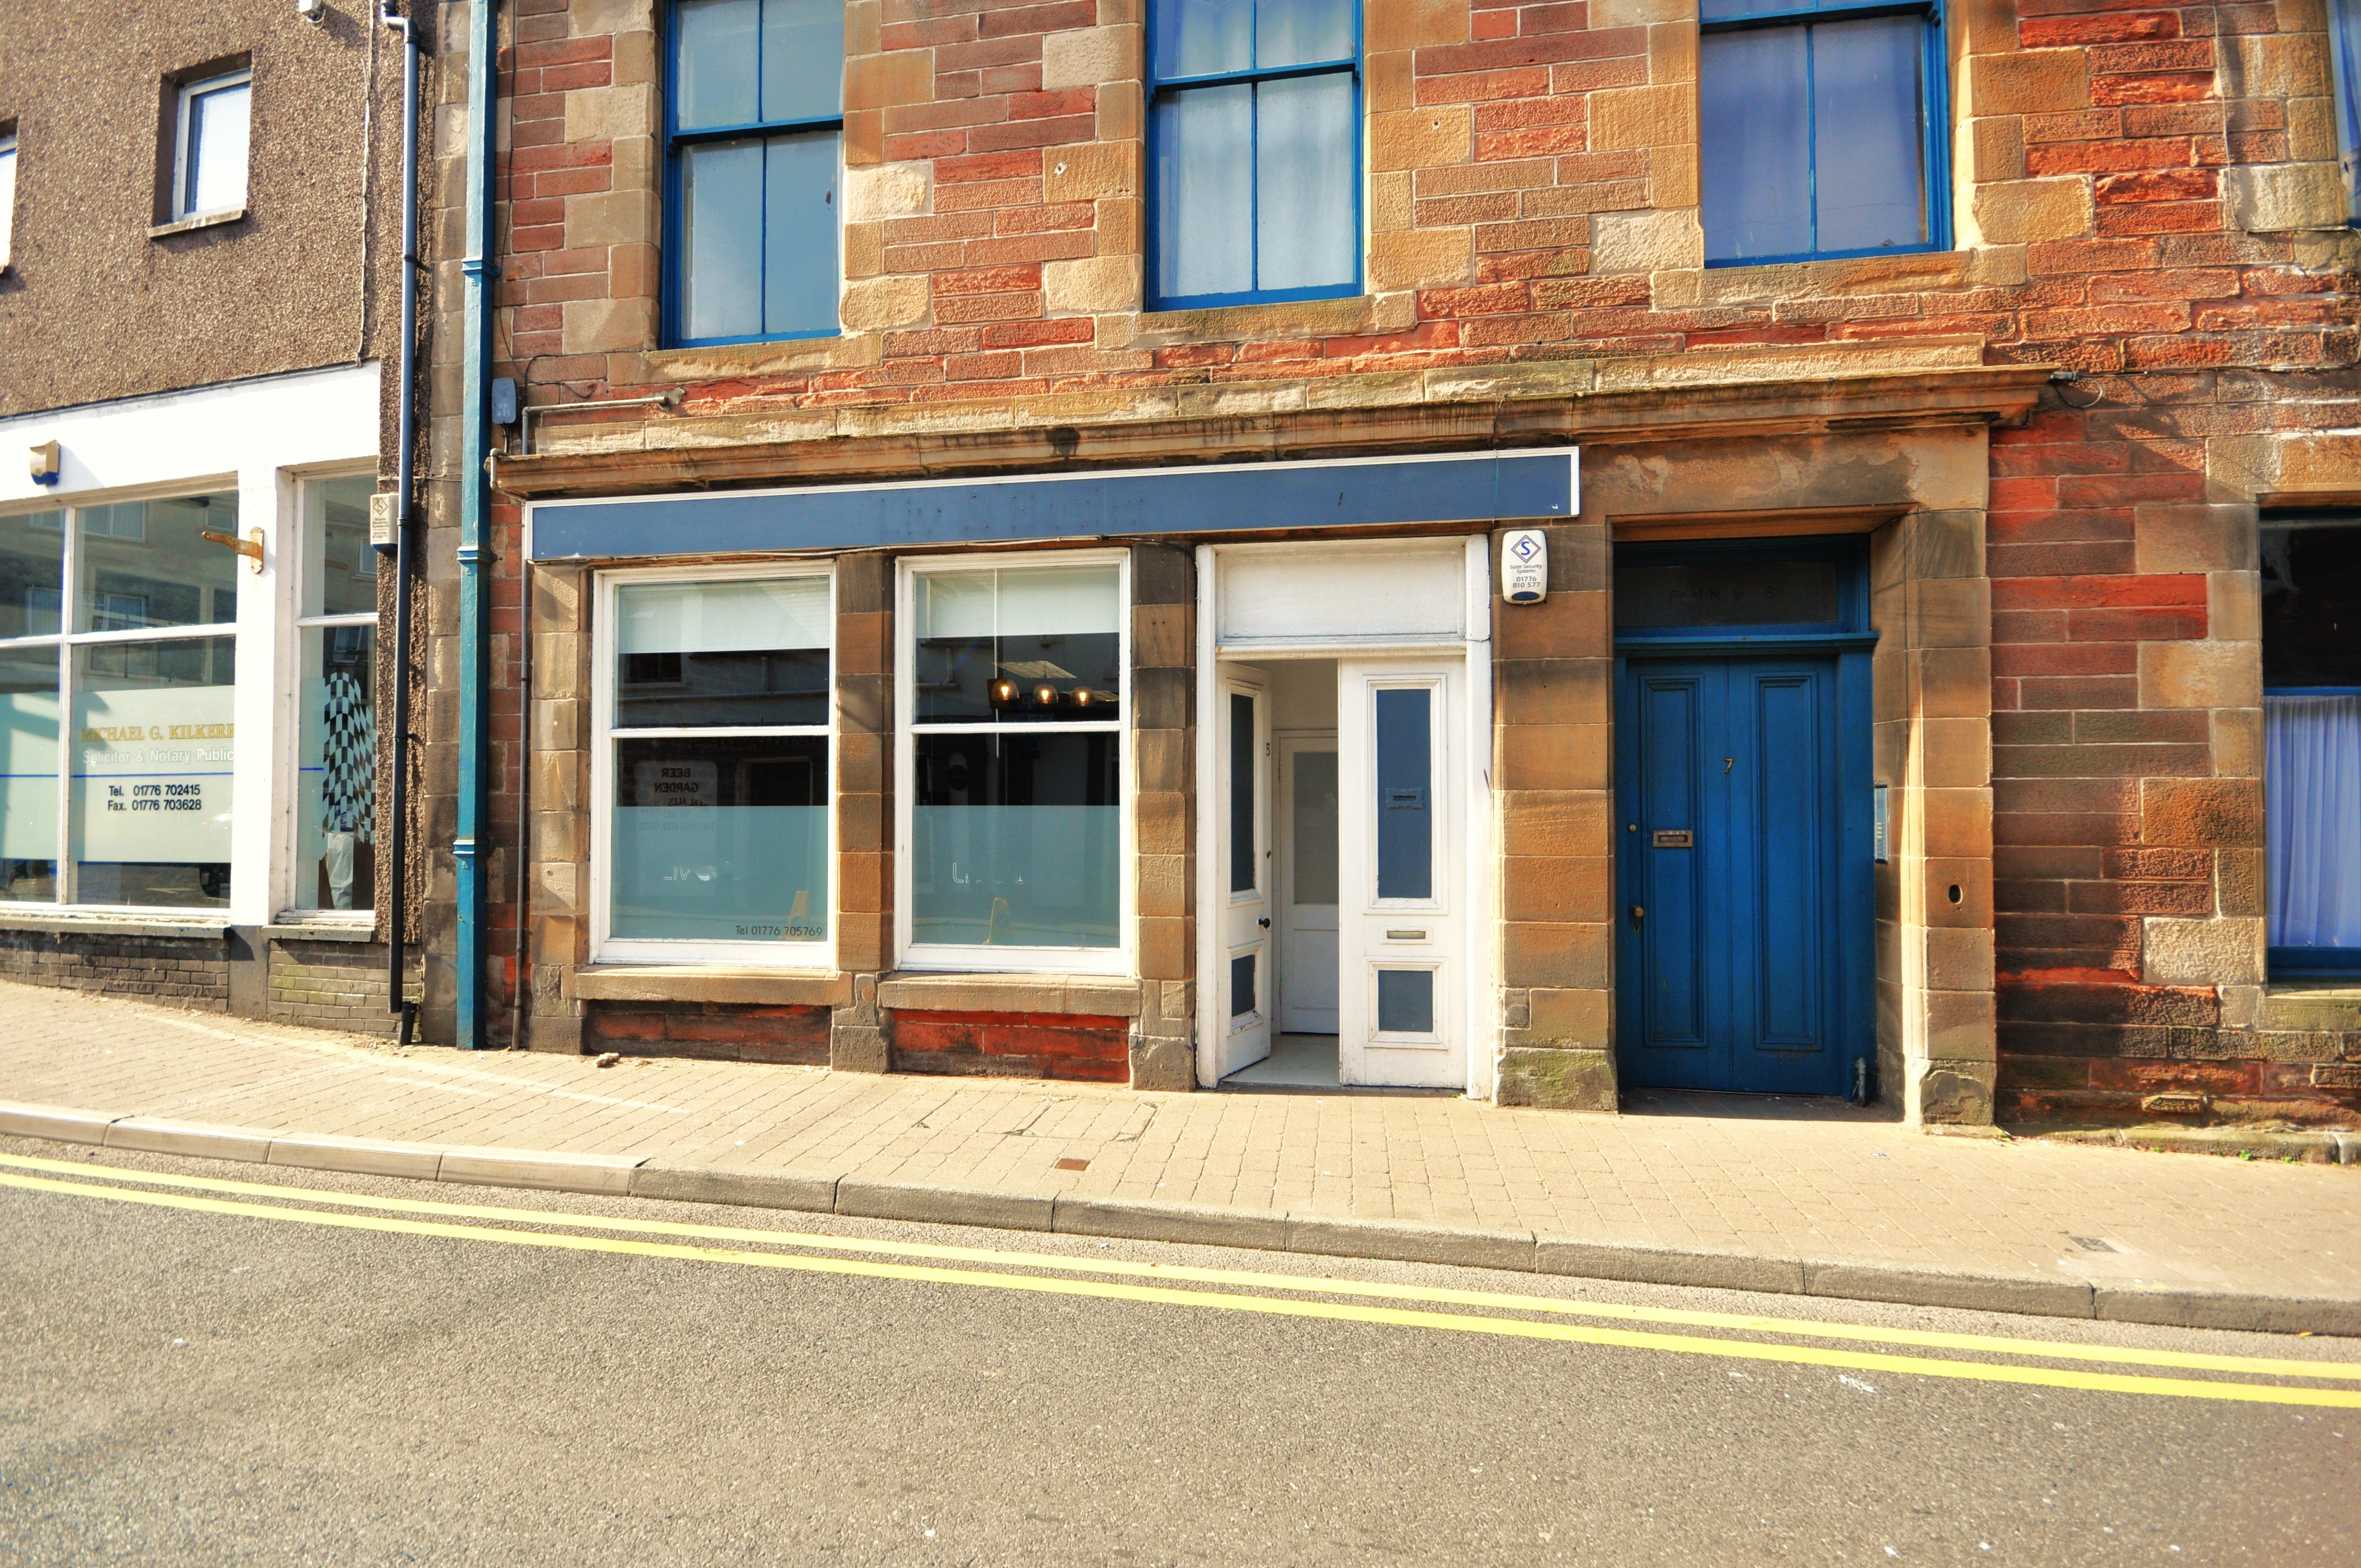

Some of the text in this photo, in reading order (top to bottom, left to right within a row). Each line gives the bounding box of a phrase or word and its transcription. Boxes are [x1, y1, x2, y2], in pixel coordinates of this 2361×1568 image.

[1521, 541, 1531, 556] S
[81, 726, 145, 742] MICHAEL
[149, 725, 164, 740] G.
[83, 747, 234, 764] Solicitor & Notary Public
[1266, 743, 1270, 756] 5
[1724, 758, 1734, 774] 7
[108, 784, 201, 797] Tel. 01776 702415
[107, 799, 202, 811] Fax. 01776 703628
[735, 925, 823, 937] Tel 01776 705769
